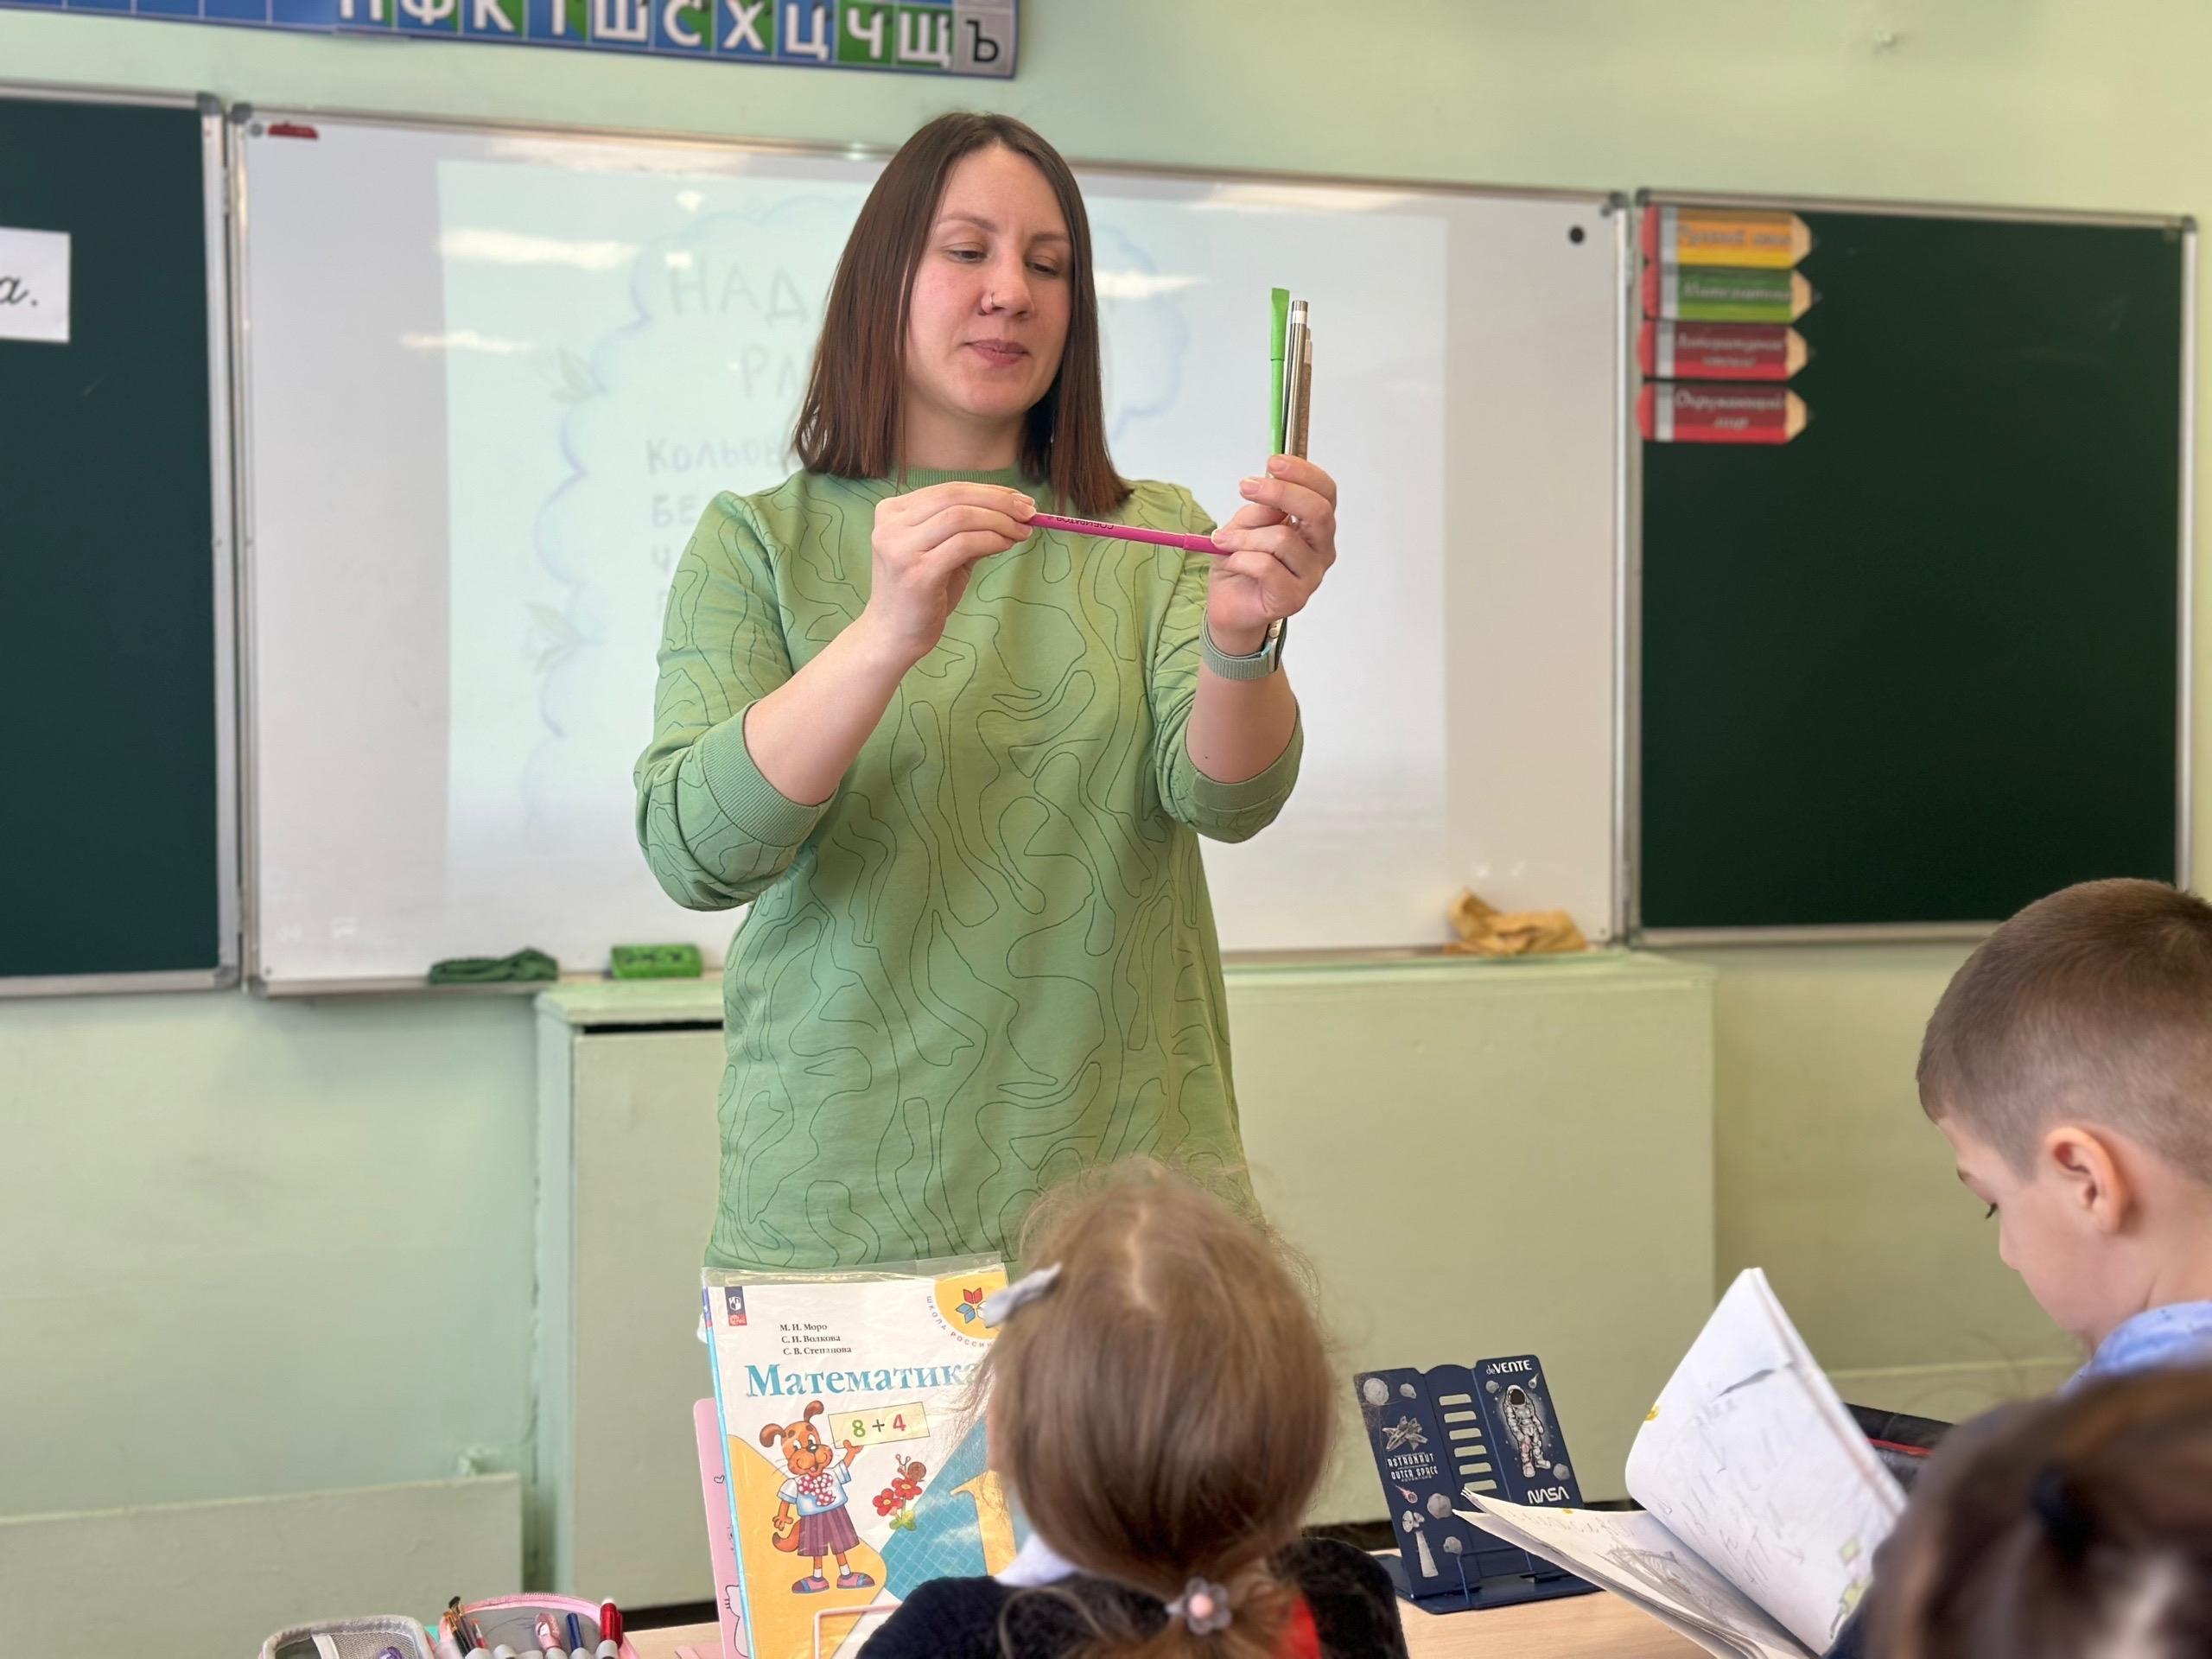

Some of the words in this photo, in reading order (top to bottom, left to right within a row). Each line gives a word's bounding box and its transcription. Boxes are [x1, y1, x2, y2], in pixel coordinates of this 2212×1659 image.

[594, 0, 648, 41] Ш
[663, 0, 701, 47] С
[722, 0, 765, 50] Х
[785, 3, 828, 60] Ц
[846, 8, 883, 58] Ч
[899, 11, 950, 67] Щ
[966, 19, 999, 62] Ъ
[926, 1295, 947, 1331] ШКОЛА
[804, 1323, 828, 1332] Моро
[744, 1362, 982, 1397] Математика
[851, 1420, 866, 1438] 8
[892, 1414, 906, 1432] 4
[1387, 1452, 1434, 1467] ASTRONAUT
[1390, 1469, 1414, 1480] OUTER
[1415, 1465, 1439, 1477] SPACE
[1527, 1485, 1570, 1504] NASA
